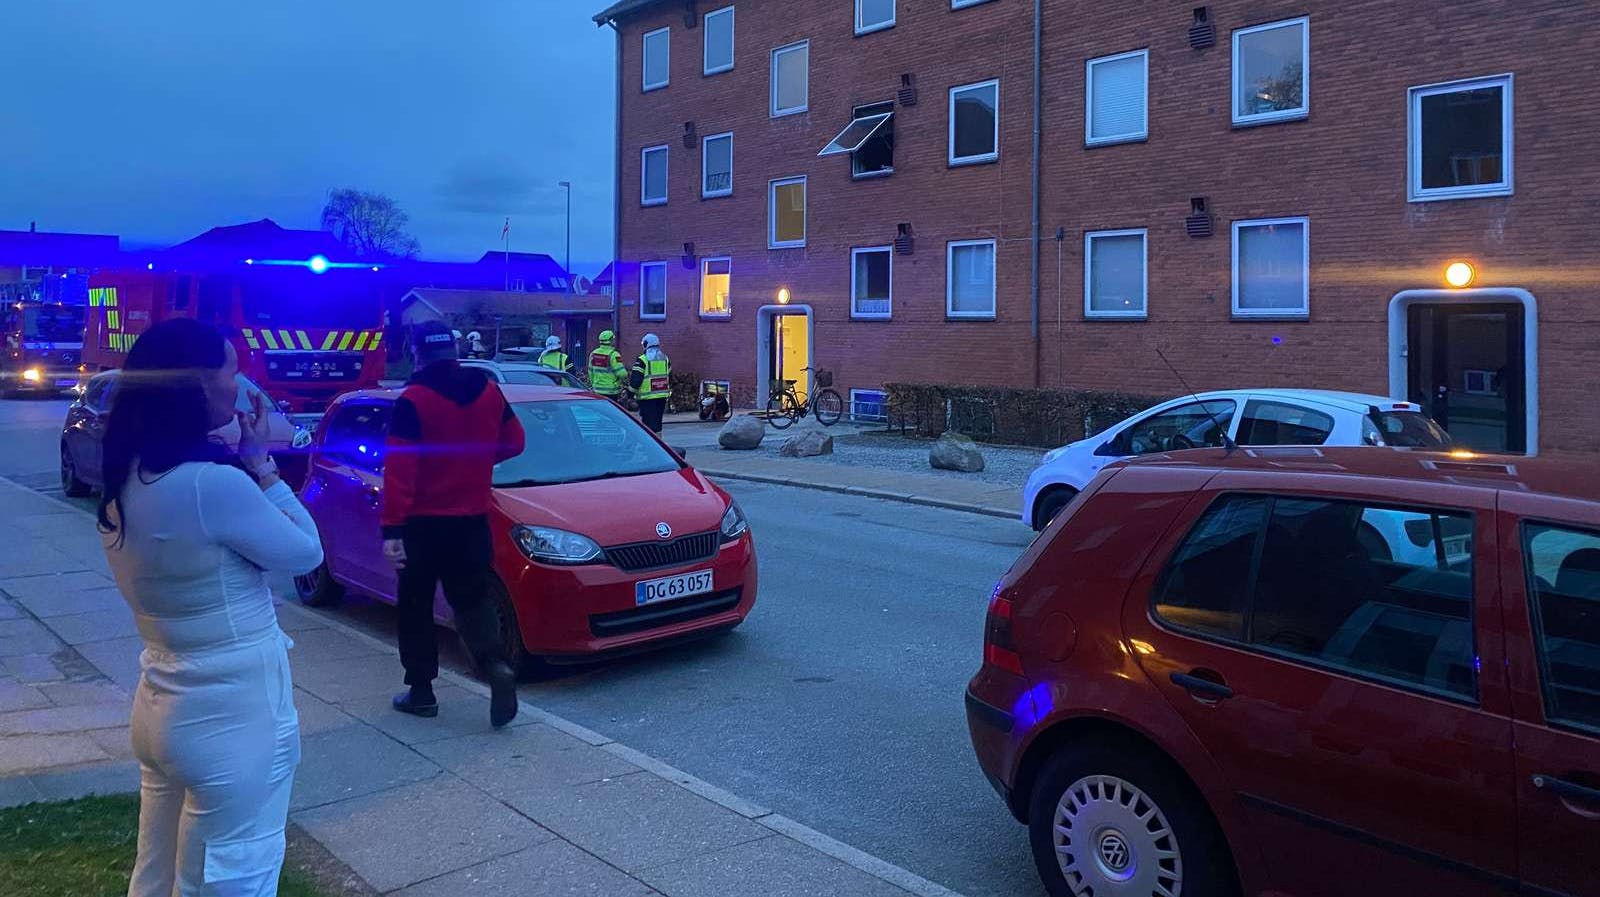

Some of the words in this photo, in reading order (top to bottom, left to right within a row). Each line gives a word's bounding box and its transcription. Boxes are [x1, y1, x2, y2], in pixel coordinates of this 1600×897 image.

[646, 582, 665, 600] DG
[669, 578, 685, 596] 63
[688, 573, 710, 591] 057
